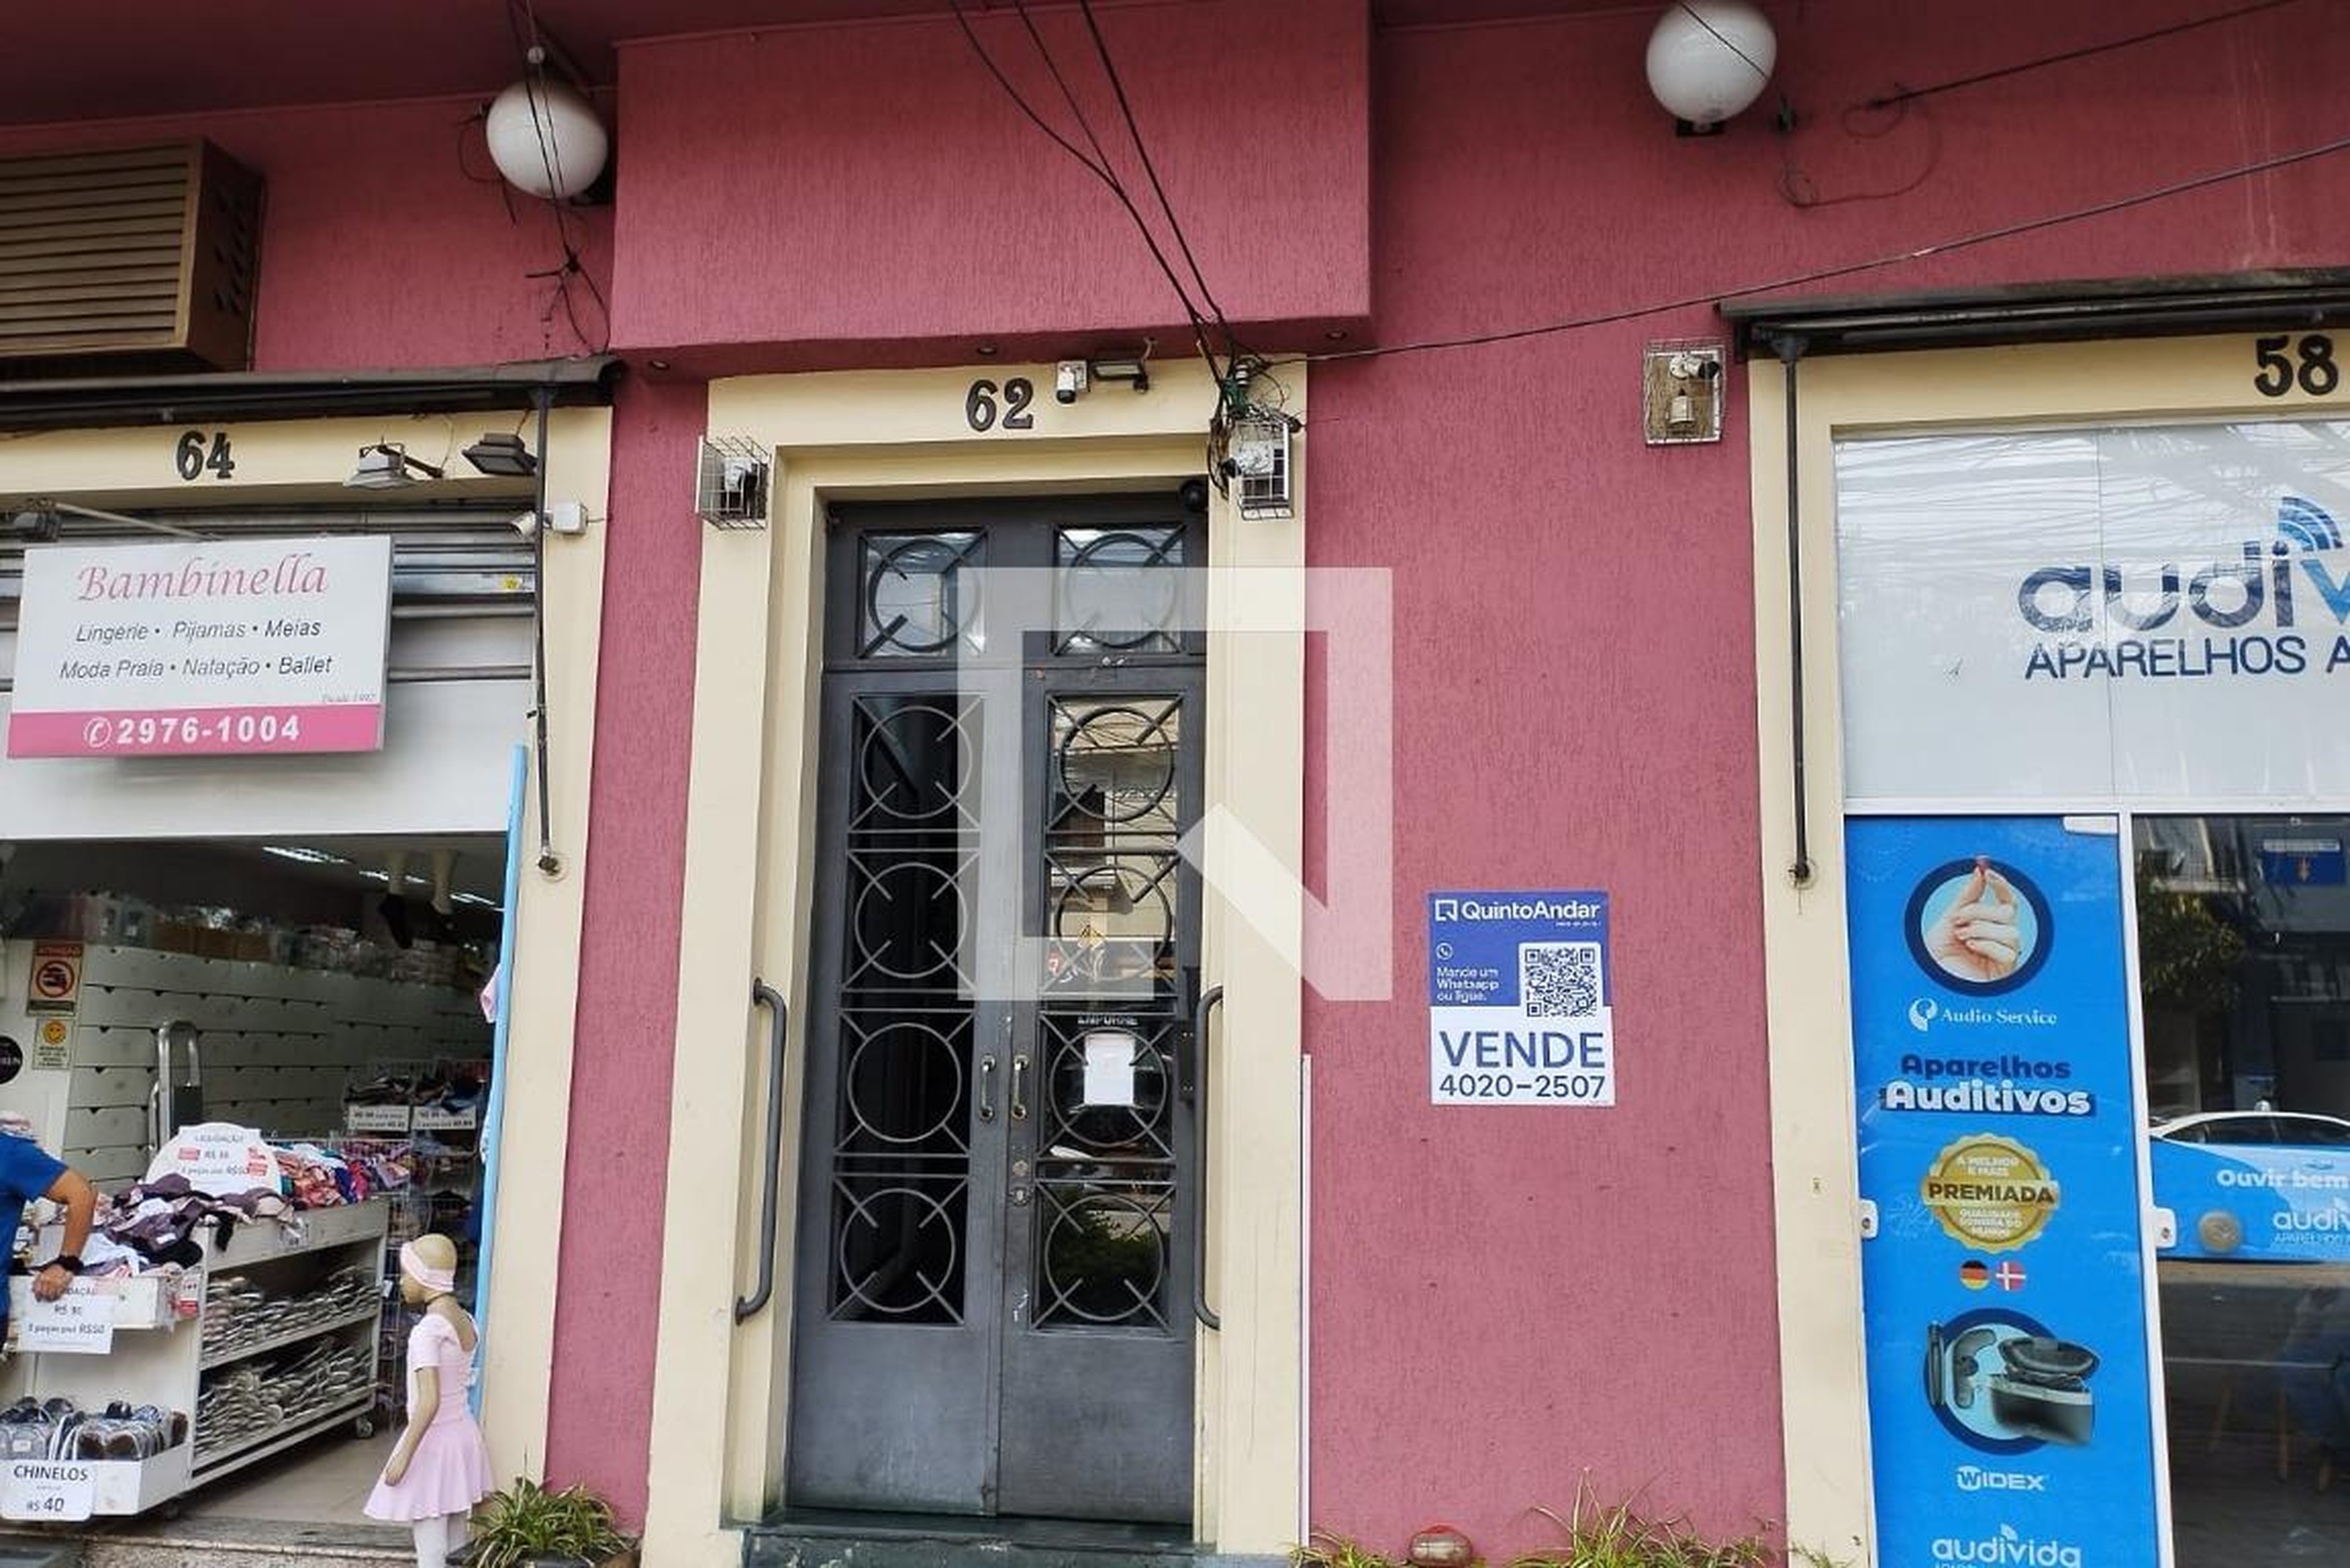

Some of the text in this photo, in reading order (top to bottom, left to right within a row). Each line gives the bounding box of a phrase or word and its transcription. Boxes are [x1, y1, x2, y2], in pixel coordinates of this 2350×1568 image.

[2255, 334, 2338, 397] 58
[966, 378, 1033, 432] 62
[177, 430, 235, 480] 64
[77, 553, 329, 601] Bambinella
[76, 619, 321, 644] Lingerie Pijamas Meias
[59, 655, 332, 679] Moda Praia Natação Ballet
[2025, 635, 2306, 679] APARELHOS
[117, 714, 300, 744] 2976-1004
[1461, 901, 1601, 920] QuintoAndar
[1940, 1009, 2058, 1025] Audio Service
[1439, 1031, 1605, 1068] VENDE
[1901, 1054, 2072, 1080] Aparelhos
[1439, 1073, 1605, 1098] 4020-2507
[1885, 1079, 2092, 1115] Auditivos
[2217, 1168, 2350, 1189] Ouvir bem
[1928, 1182, 2055, 1203] PREMIADA
[13, 1465, 88, 1481] CHINELOS
[1958, 1465, 2046, 1491] WIDEX
[43, 1497, 64, 1512] 40
[1931, 1537, 2081, 1568] audivida
